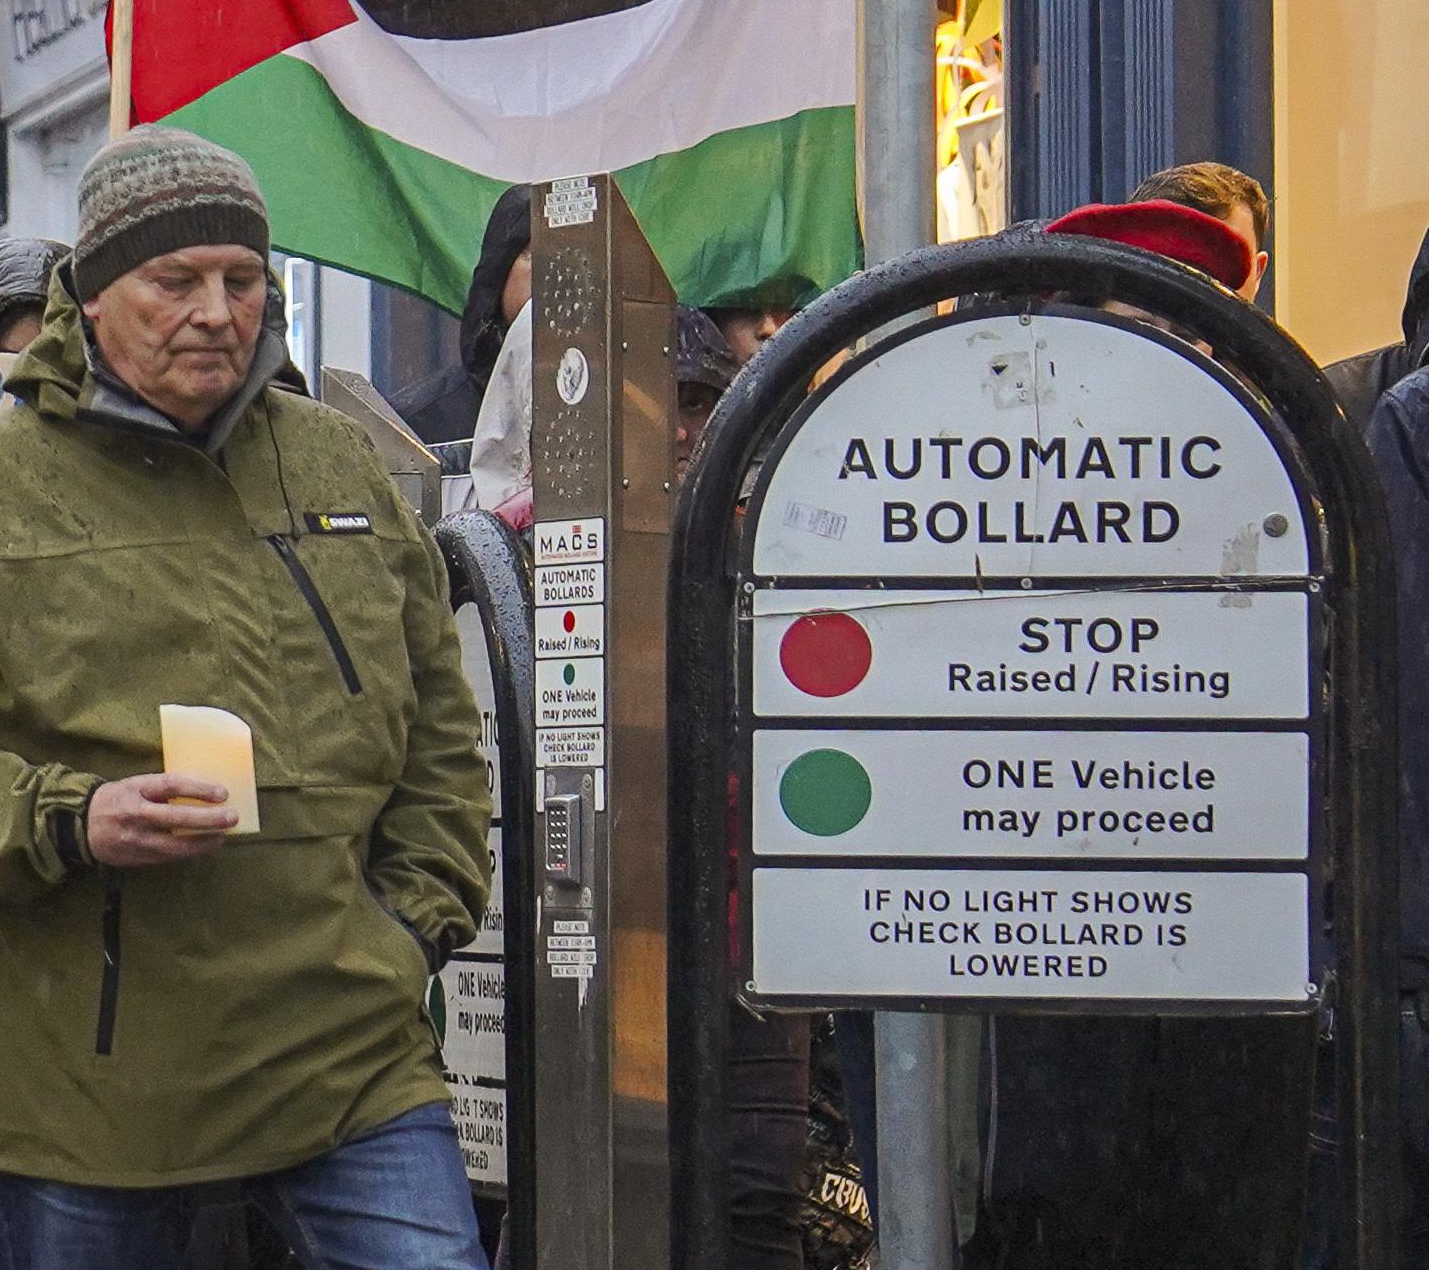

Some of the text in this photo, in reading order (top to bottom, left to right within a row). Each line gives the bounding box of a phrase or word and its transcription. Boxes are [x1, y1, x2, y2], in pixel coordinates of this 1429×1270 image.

[838, 435, 1222, 481] AUTOMATIC
[882, 501, 1180, 544] BOLLARD
[541, 533, 597, 553] MACS
[541, 569, 595, 585] AUTOMATIC
[544, 585, 594, 600] BOLLARDS
[538, 637, 566, 651] Raised
[574, 636, 600, 651] Rising
[1019, 617, 1160, 654] STOP
[948, 662, 1076, 693] Raised
[1113, 662, 1231, 699] Rising
[543, 689, 596, 703] ONE Vehicle
[543, 706, 596, 721] may proceed
[544, 742, 595, 752] CHECK BOLLARD
[546, 733, 555, 742] NO
[557, 732, 575, 741] LIGHT
[577, 731, 600, 741] SHOWS
[558, 754, 589, 763] LOWERED
[963, 760, 1216, 789] ONE Vehicle
[963, 805, 1215, 838] may proceed
[864, 889, 1193, 914] IF NO LIGHT SHOWS
[870, 922, 1186, 946] CHECK BOLLARD IS
[950, 955, 1108, 977] LOWERED
[458, 971, 505, 1001] ONE Vehicle
[458, 1011, 473, 1036] may
[480, 1099, 504, 1122] SHOWS
[466, 1122, 494, 1145] BOLLARD
[496, 1126, 503, 1148] IS
